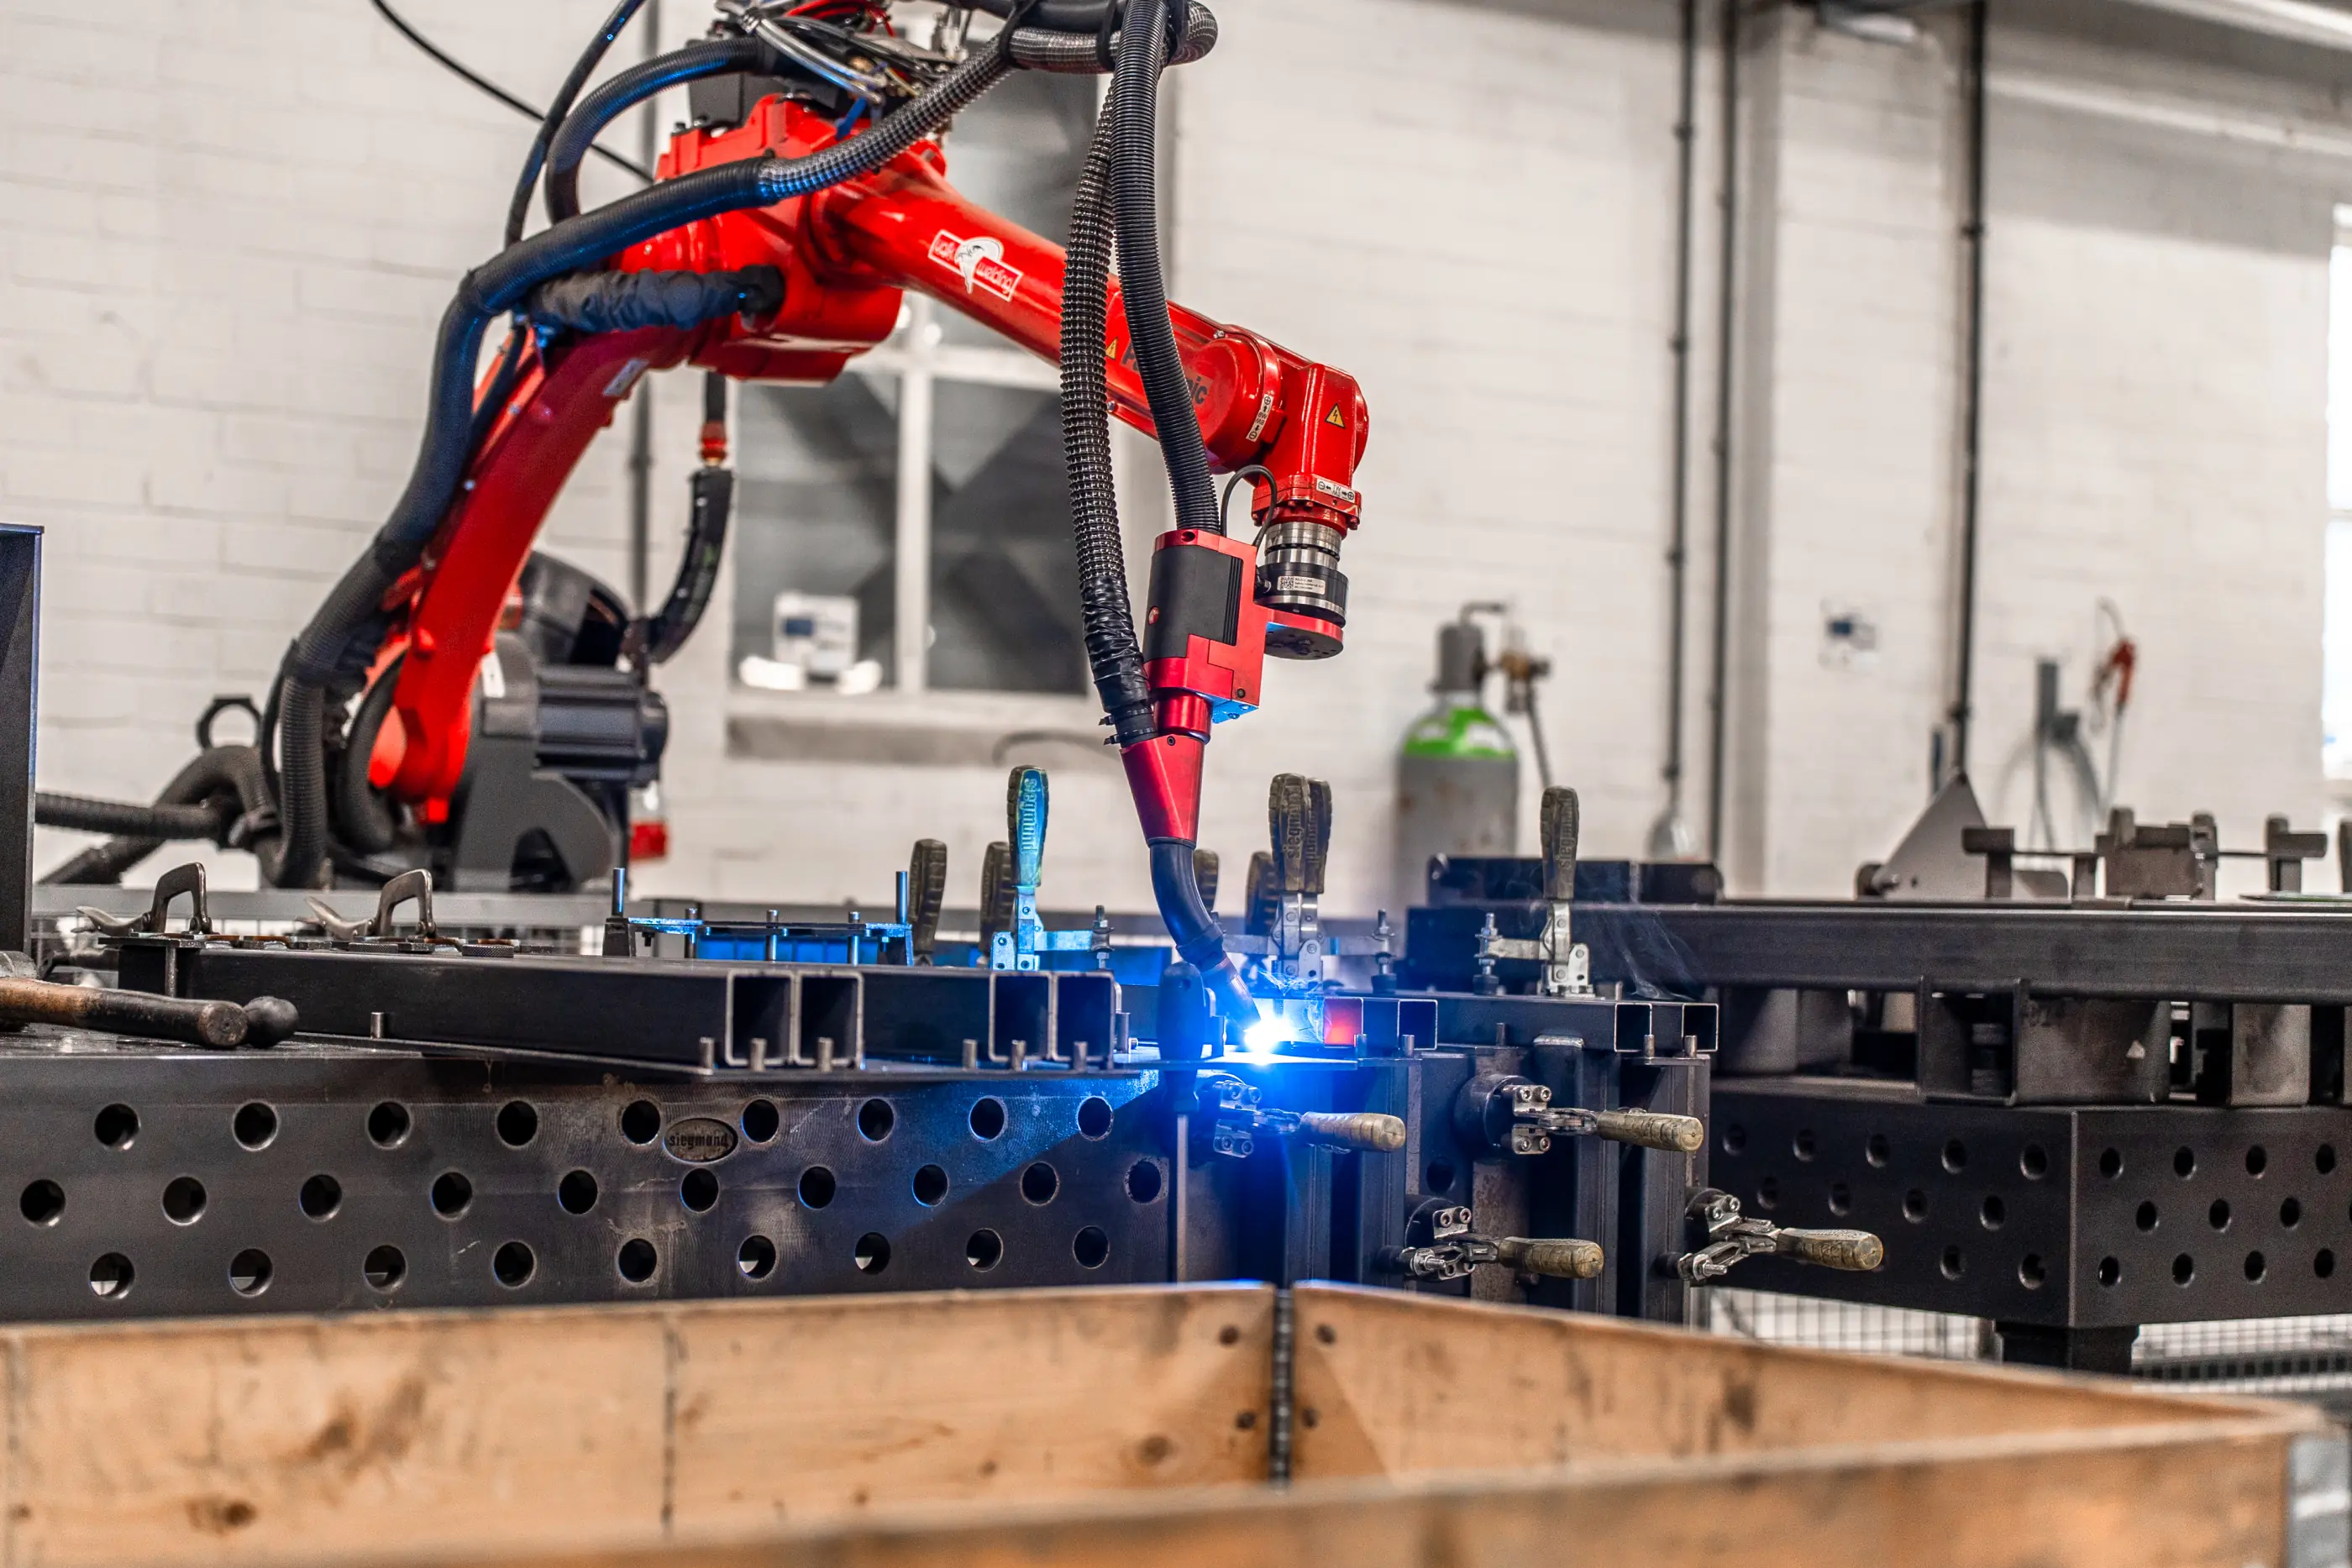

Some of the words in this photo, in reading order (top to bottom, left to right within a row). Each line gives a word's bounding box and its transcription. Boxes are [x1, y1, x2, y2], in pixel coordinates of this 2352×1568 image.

[976, 262, 1013, 294] welding
[1019, 778, 1041, 852] siegmund
[669, 1131, 728, 1150] siegmund
